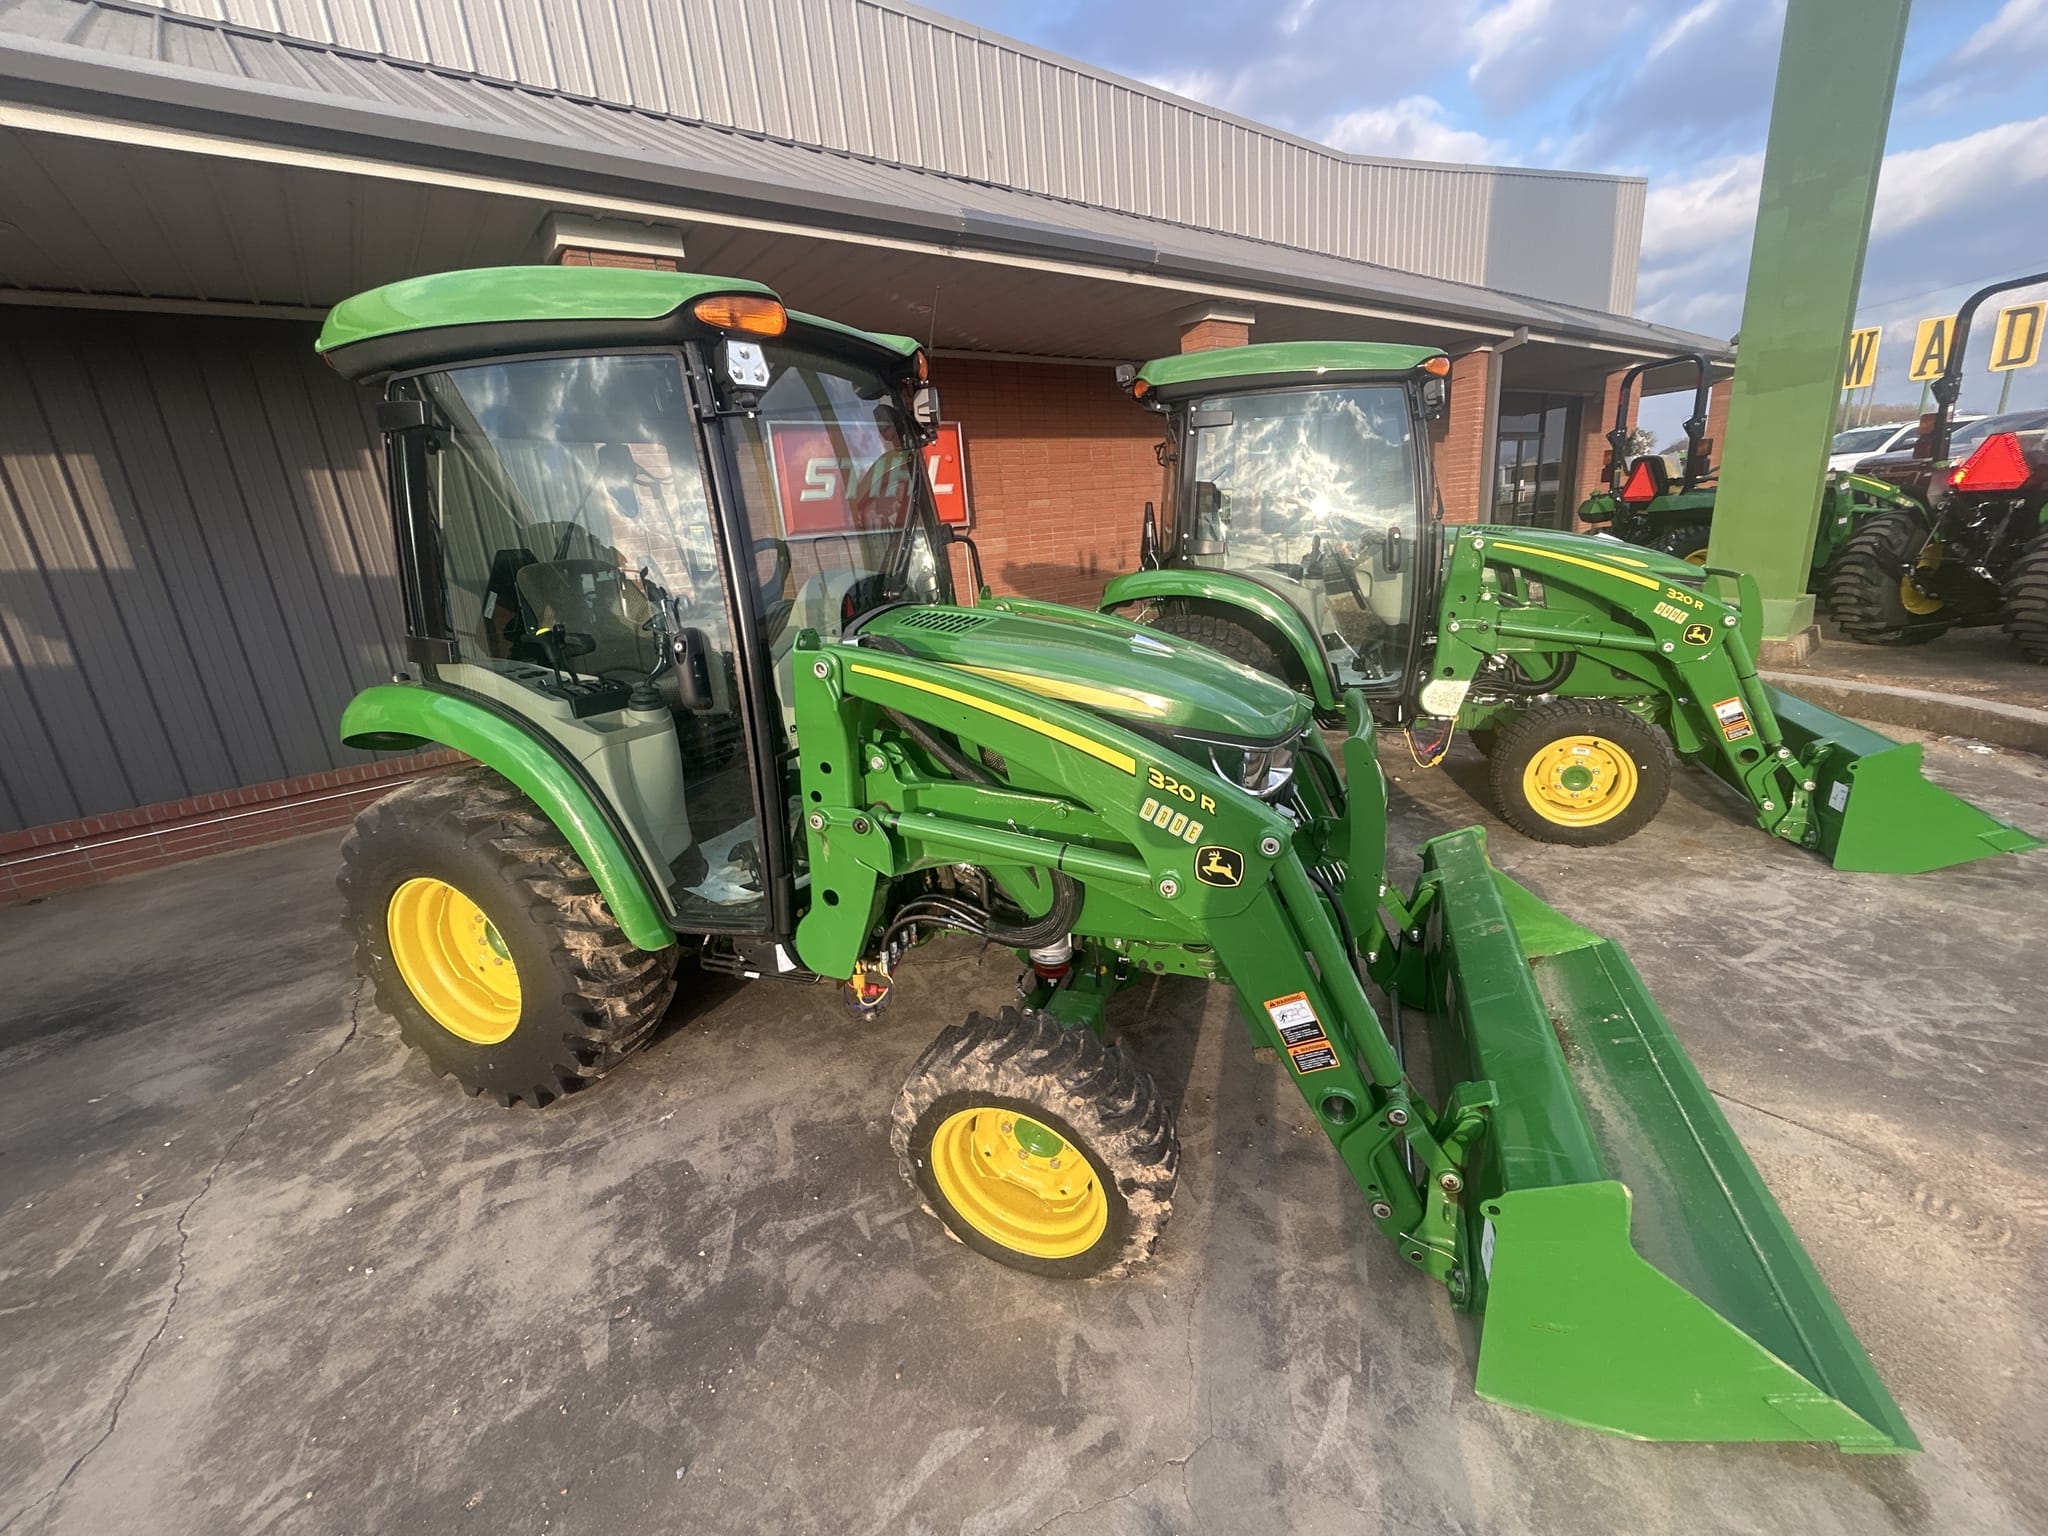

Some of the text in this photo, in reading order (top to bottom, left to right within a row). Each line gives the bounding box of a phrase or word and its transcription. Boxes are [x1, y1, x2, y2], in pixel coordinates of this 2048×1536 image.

[1666, 587, 1704, 611] 320 R
[1148, 767, 1216, 815] 320 R
[1143, 801, 1200, 841] WADE
[1276, 995, 1302, 1005] WARNING
[1300, 1043, 1326, 1052] WARNING
